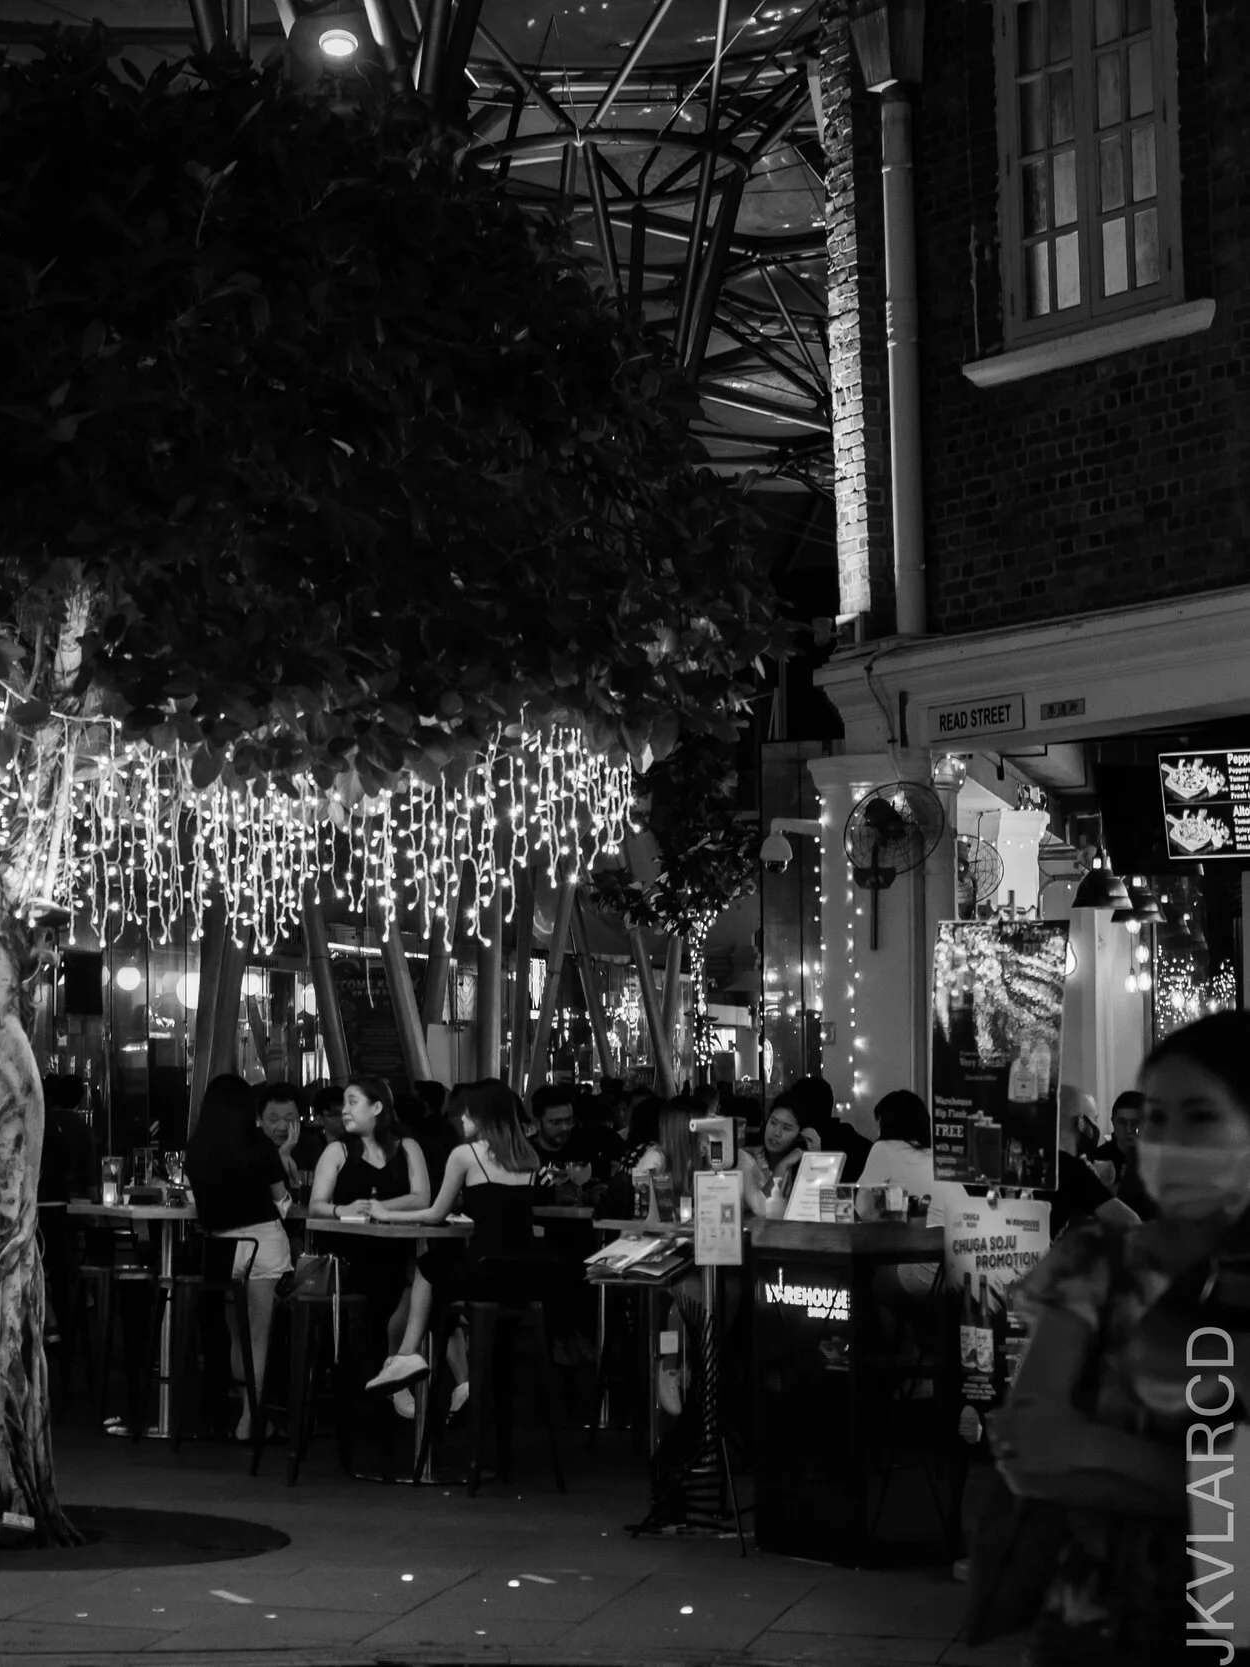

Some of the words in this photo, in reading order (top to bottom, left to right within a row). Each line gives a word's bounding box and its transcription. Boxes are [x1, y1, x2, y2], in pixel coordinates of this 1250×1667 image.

[939, 712, 968, 732] READ
[970, 704, 1011, 728] STREET
[935, 1124, 964, 1138] FREE
[952, 1238, 987, 1255] CHUGA
[989, 1235, 1017, 1251] SOJU
[975, 1251, 1040, 1270] PROMOTION
